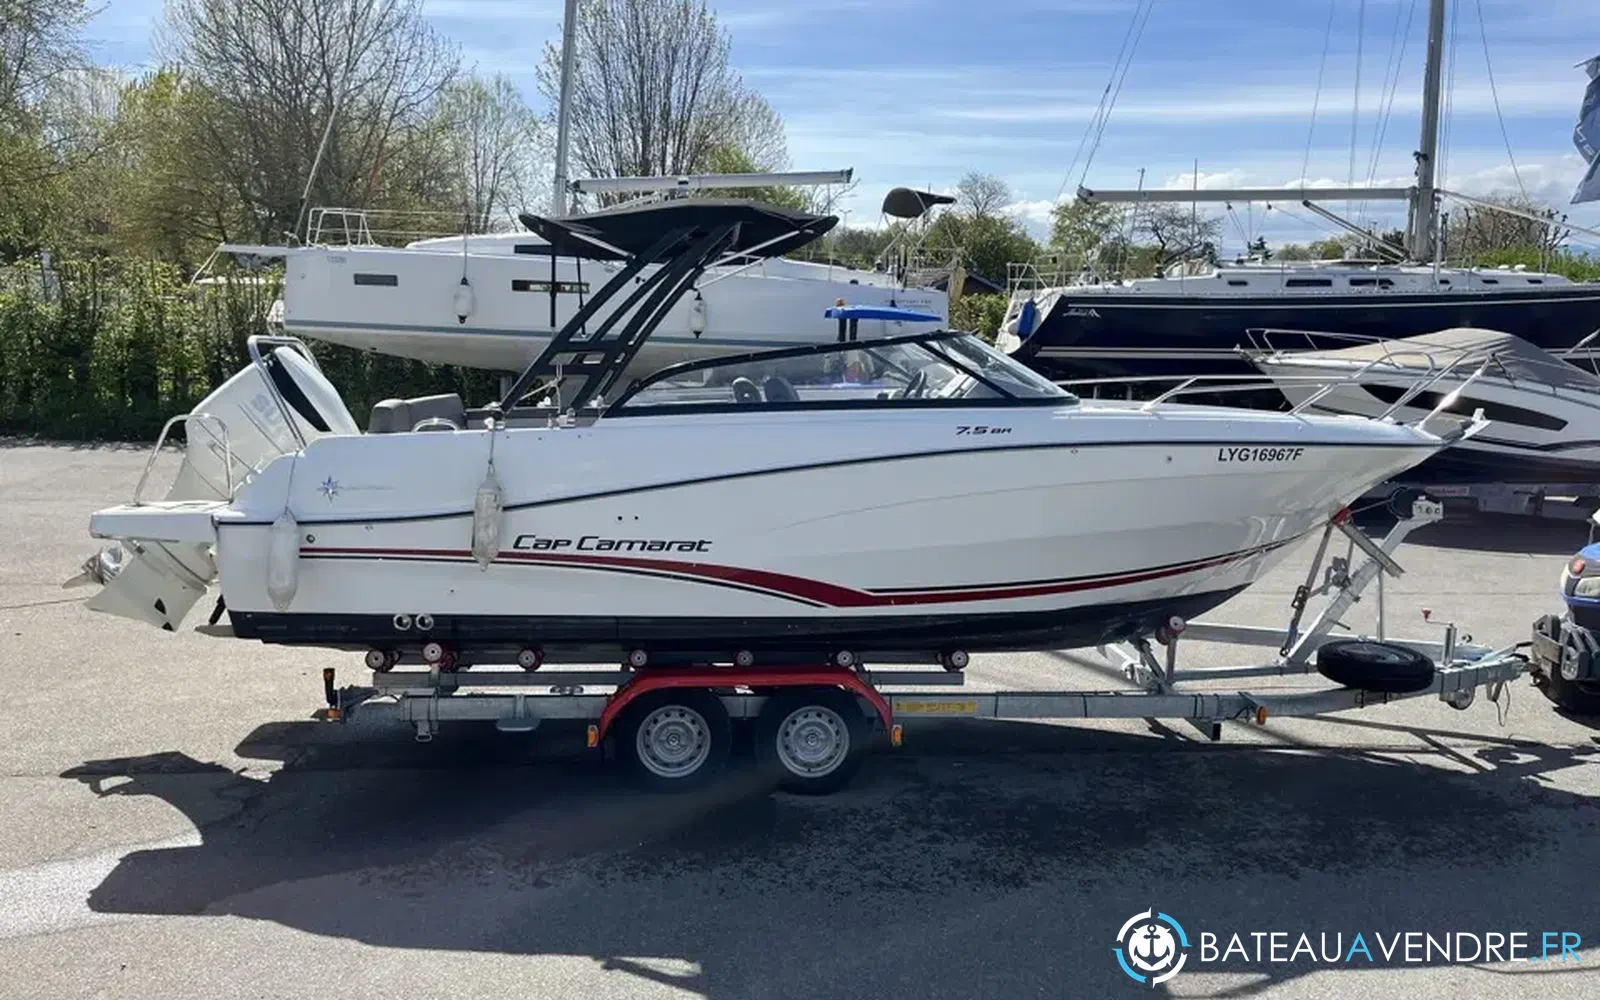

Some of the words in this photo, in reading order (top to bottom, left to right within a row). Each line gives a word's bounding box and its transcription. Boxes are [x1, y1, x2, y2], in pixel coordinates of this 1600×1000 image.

[956, 426, 988, 435] 7.5
[1218, 448, 1304, 462] LYG16967F
[513, 535, 571, 550] Cap
[576, 536, 712, 552] Camarat
